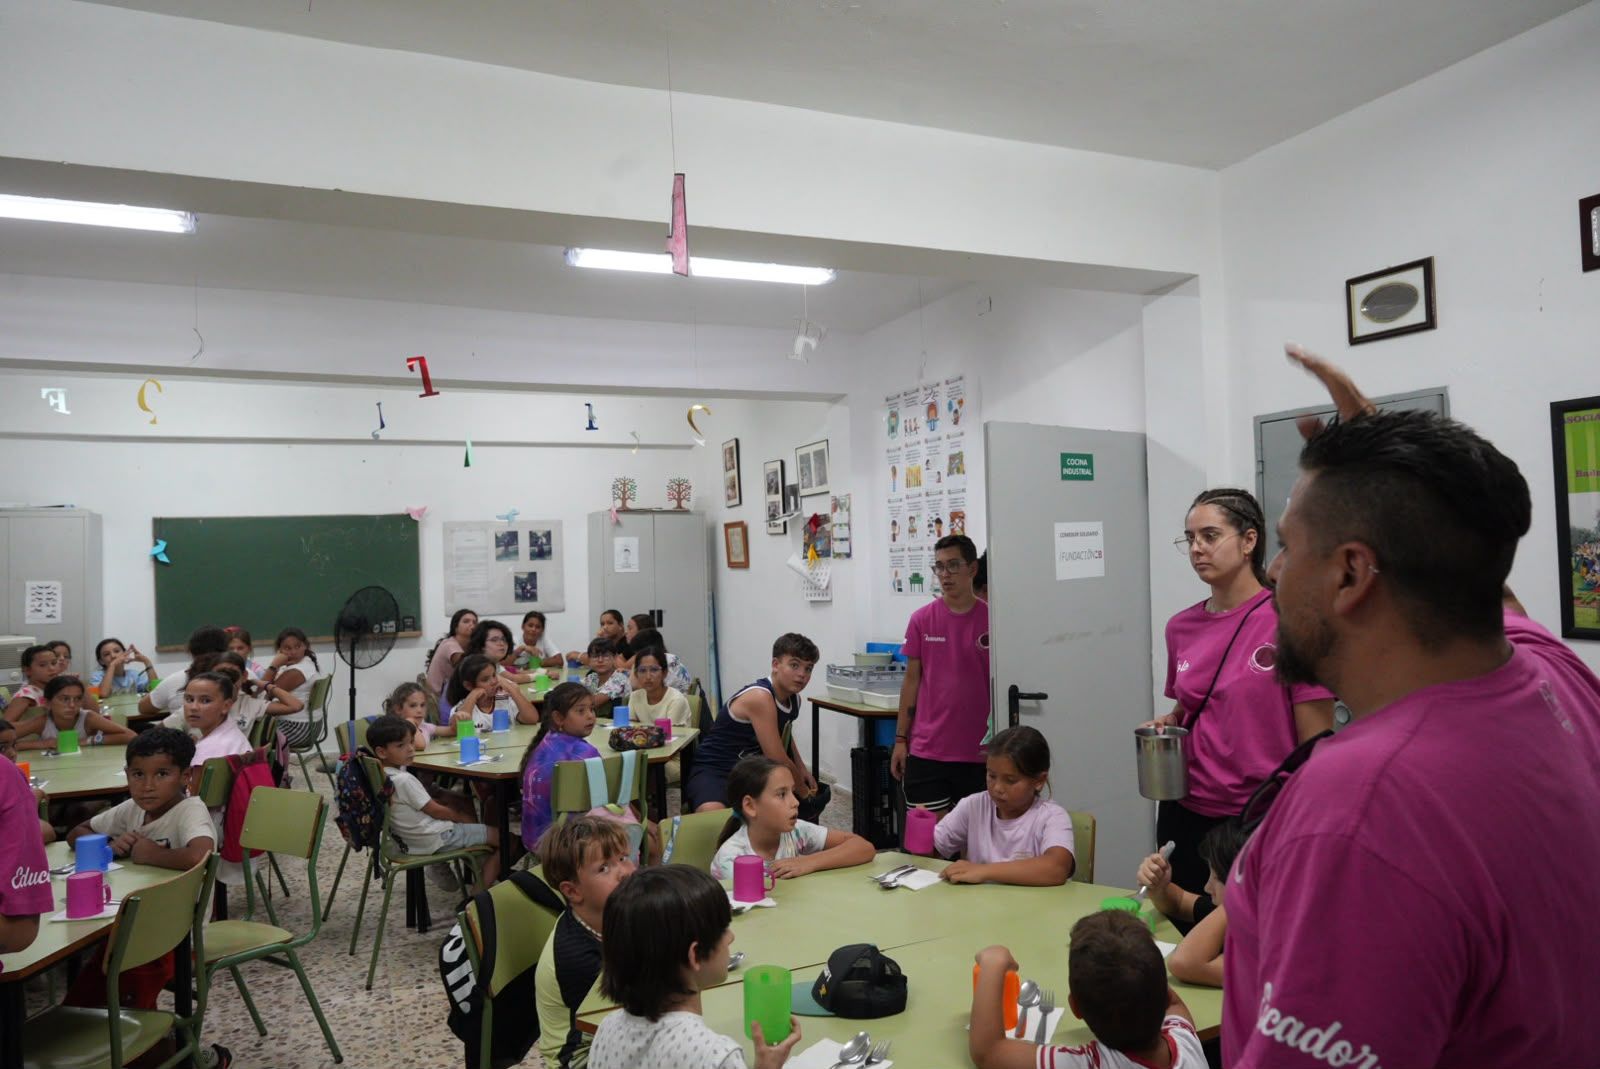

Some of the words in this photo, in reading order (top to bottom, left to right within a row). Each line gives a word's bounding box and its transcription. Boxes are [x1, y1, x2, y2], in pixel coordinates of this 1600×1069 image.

[1066, 458, 1088, 466] COCINA
[1062, 467, 1093, 476] INDUSTRIAL
[1256, 981, 1382, 1069] cador
